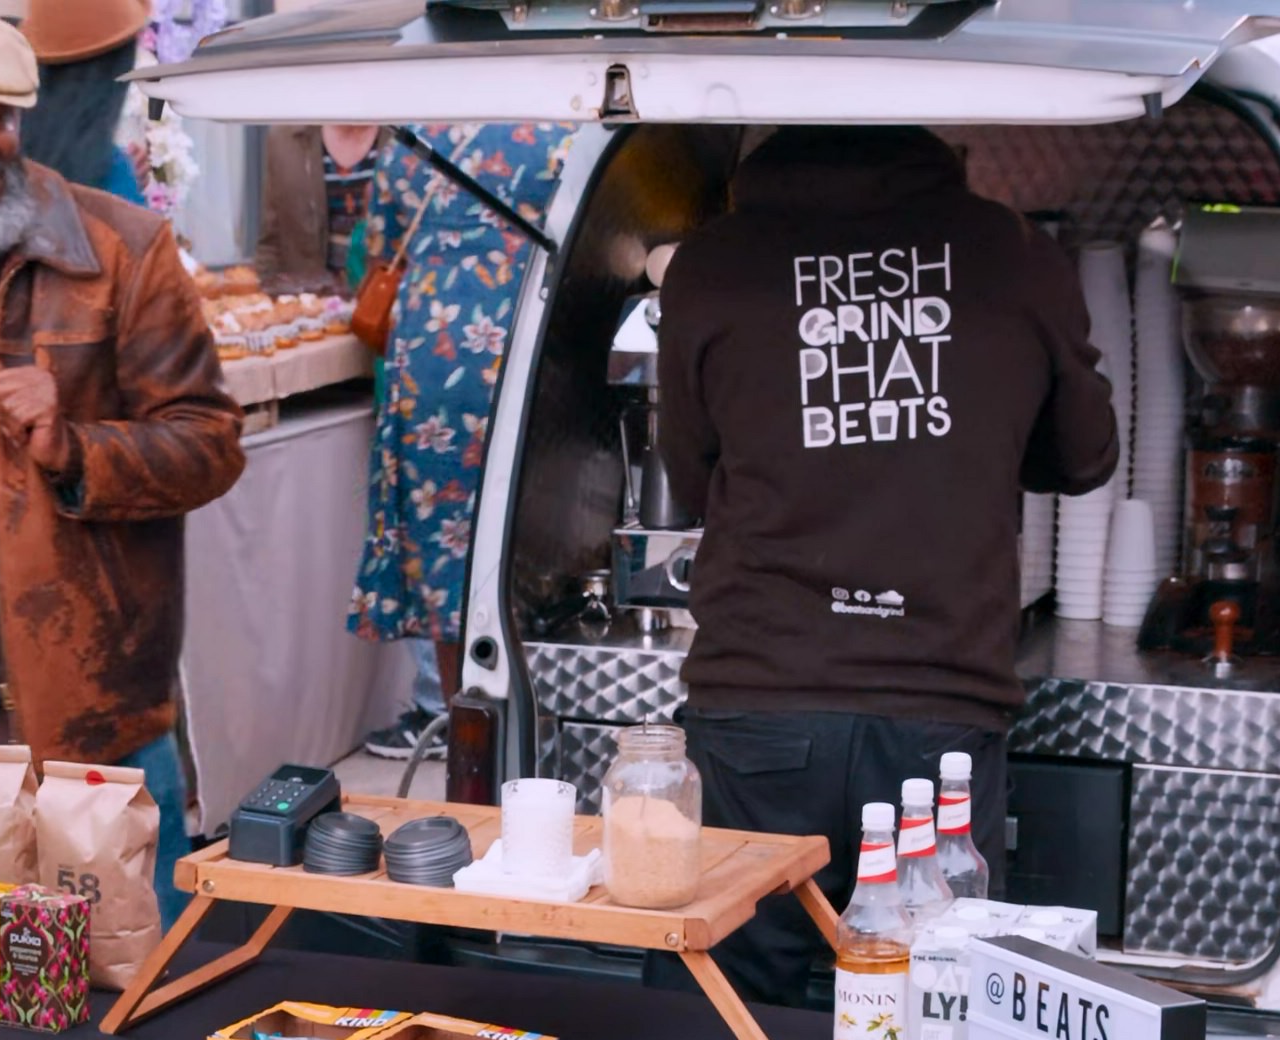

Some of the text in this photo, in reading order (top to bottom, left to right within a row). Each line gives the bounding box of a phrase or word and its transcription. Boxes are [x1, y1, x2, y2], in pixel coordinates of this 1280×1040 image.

[794, 242, 951, 306] FRESH
[798, 296, 951, 346] GRIND
[799, 335, 951, 405] PHAT
[58, 870, 101, 903] 58
[9, 933, 42, 946] pukka
[838, 989, 897, 1006] MONIN
[922, 992, 968, 1021] LY!
[335, 1017, 389, 1028] KIND
